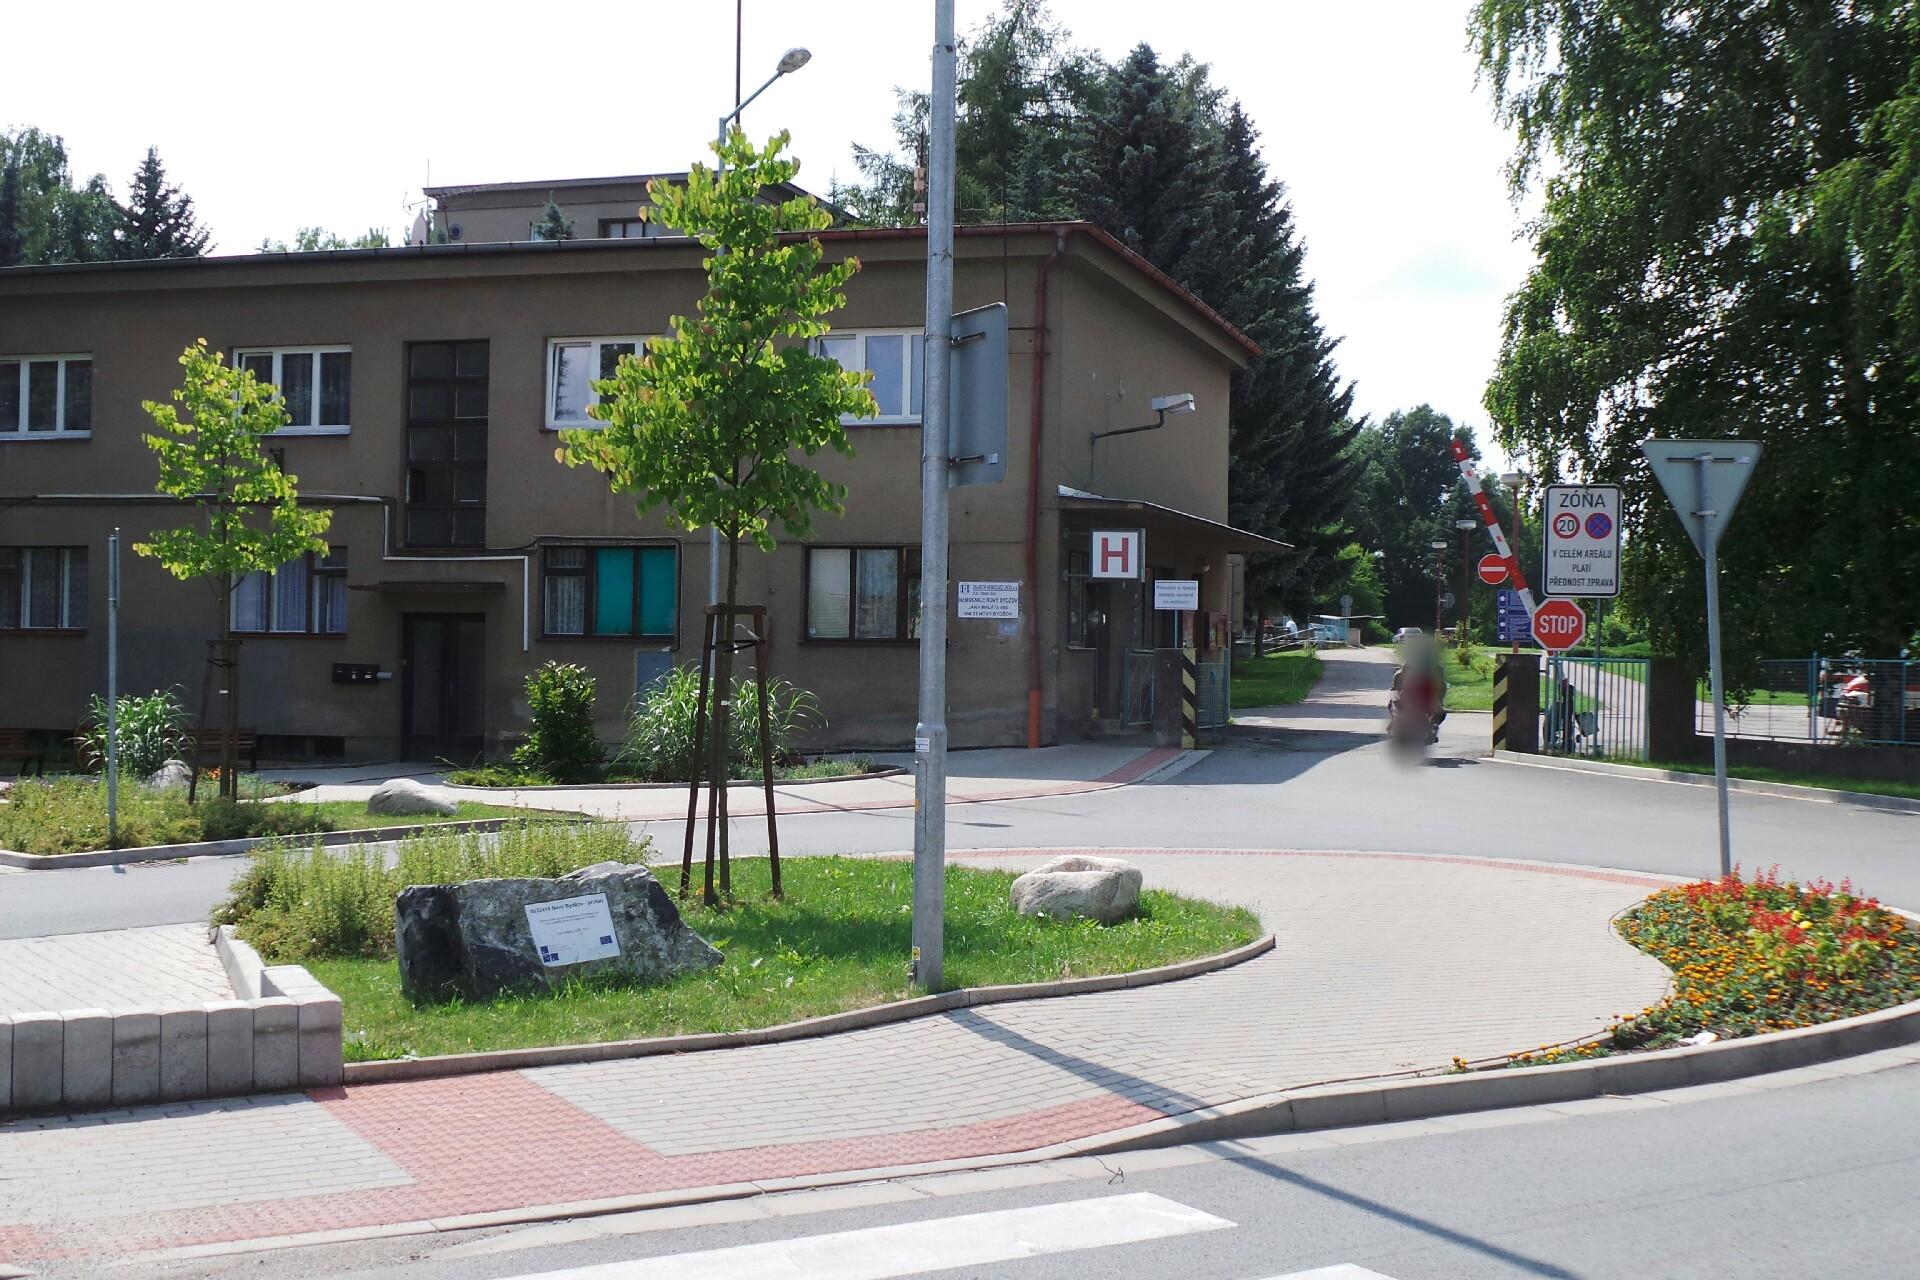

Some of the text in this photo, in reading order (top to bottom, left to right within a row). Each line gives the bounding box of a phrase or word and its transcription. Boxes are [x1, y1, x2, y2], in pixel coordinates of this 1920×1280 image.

[1559, 519, 1575, 532] 20
[1100, 537, 1129, 573] H
[1553, 549, 1612, 558] V CELÉM AREÁLU
[1572, 563, 1592, 572] PLATÍ
[1549, 576, 1614, 587] PŘEDNOST ZPRAVA
[1539, 615, 1577, 634] STOP
